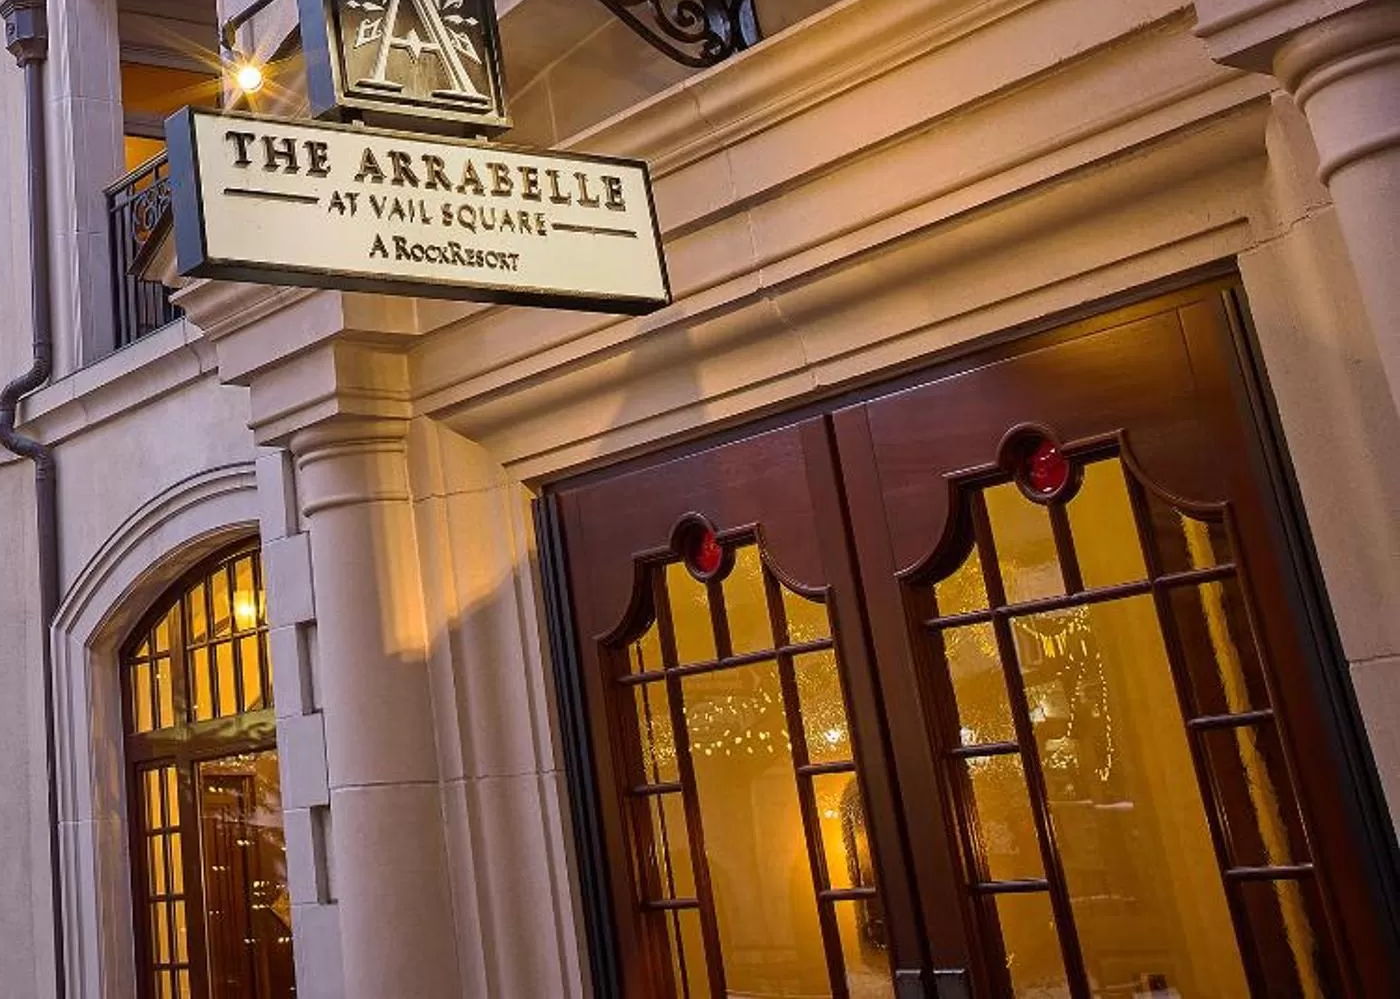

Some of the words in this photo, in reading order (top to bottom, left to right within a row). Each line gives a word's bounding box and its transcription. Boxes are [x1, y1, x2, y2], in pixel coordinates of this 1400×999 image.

[225, 130, 331, 178] THE
[353, 147, 627, 212] ARRABELLE
[328, 190, 359, 217] AT
[369, 195, 432, 225] VAIL
[441, 203, 548, 237] SQUARE
[369, 233, 389, 258] A
